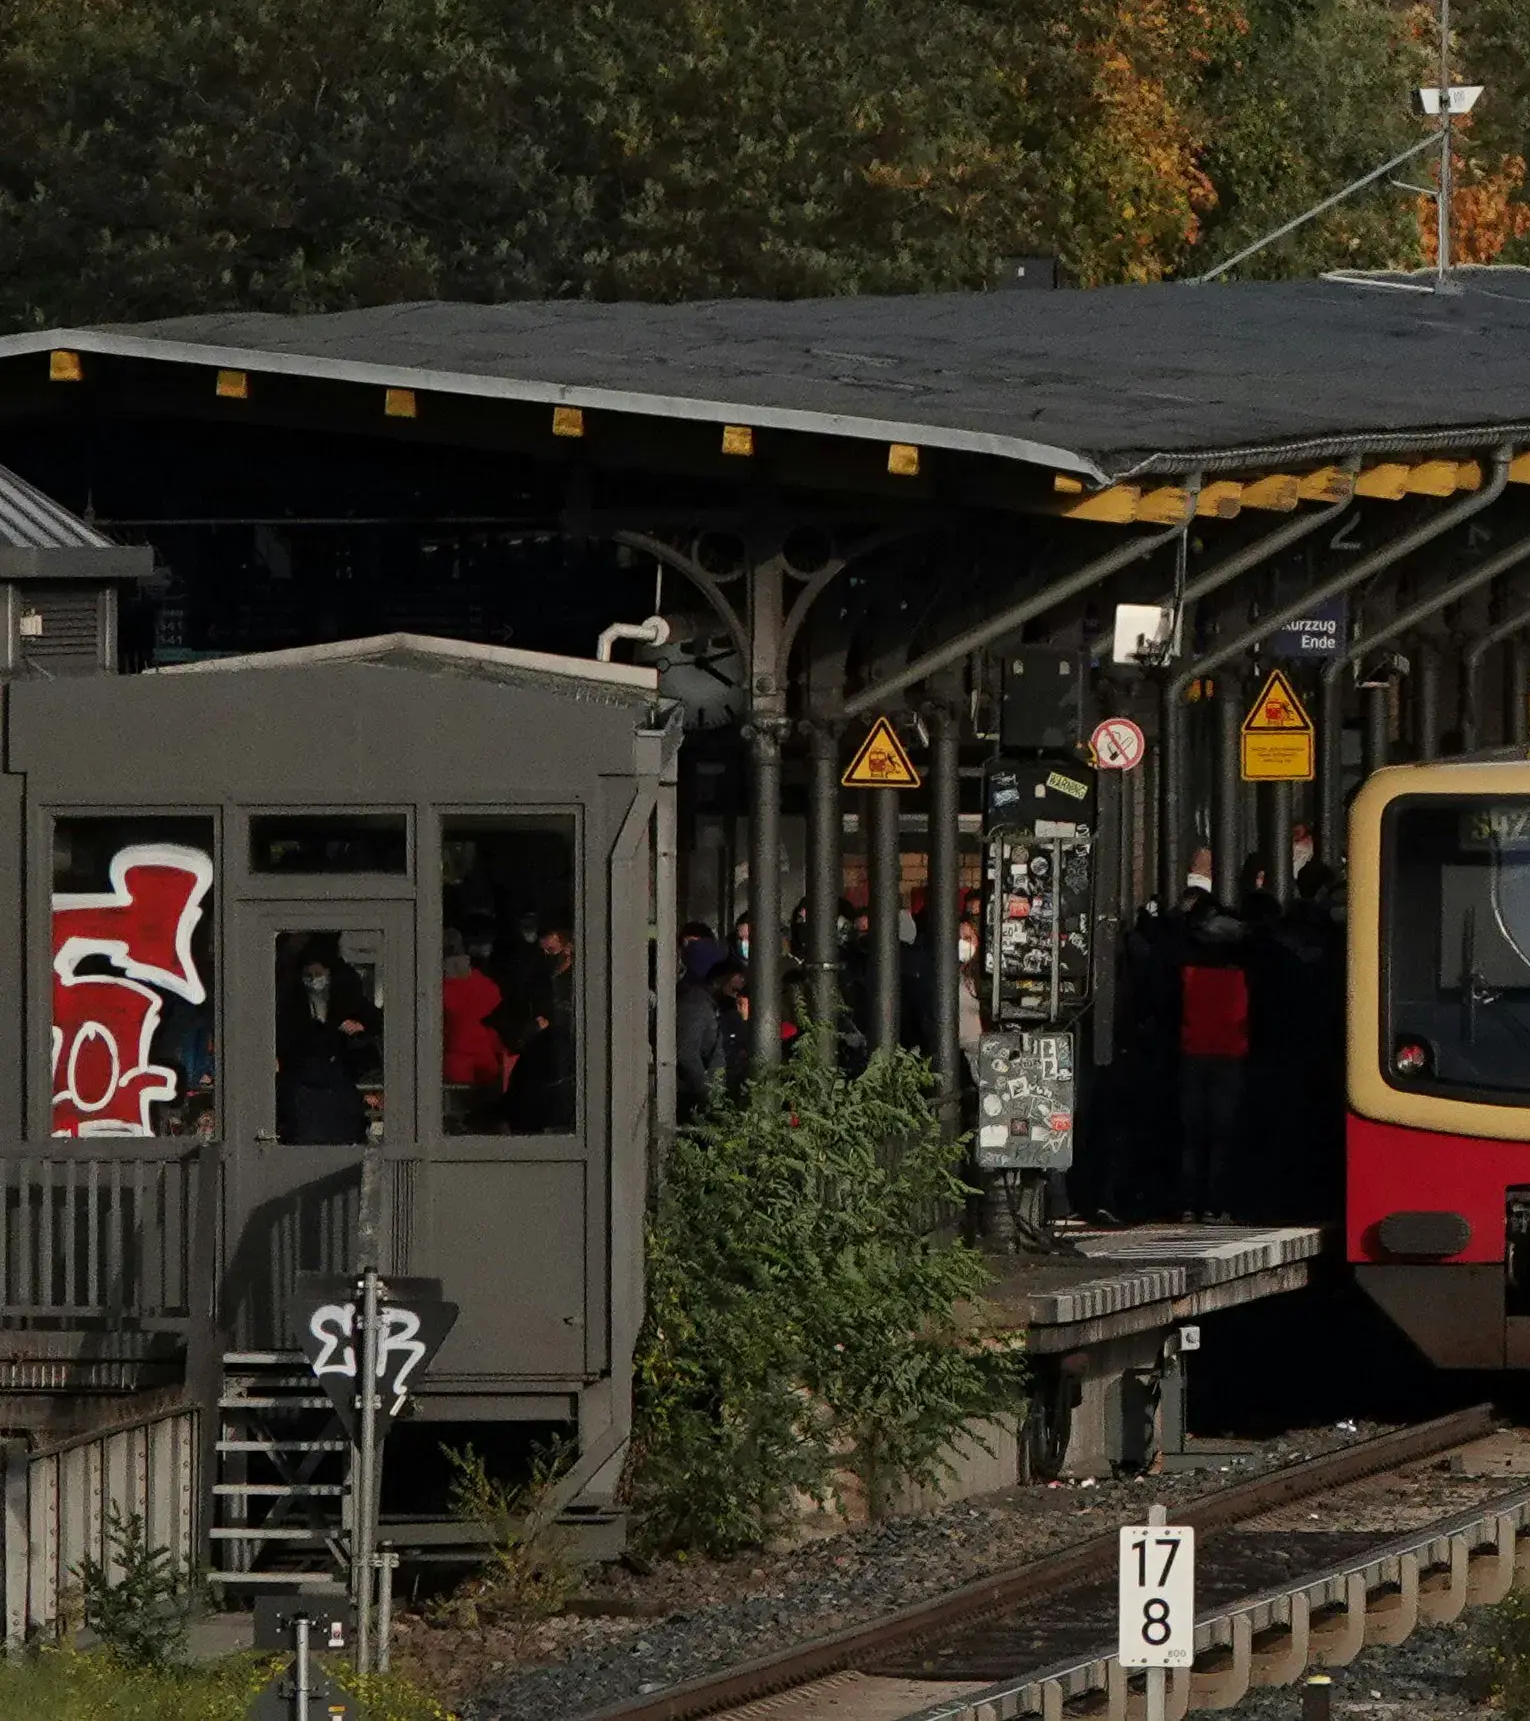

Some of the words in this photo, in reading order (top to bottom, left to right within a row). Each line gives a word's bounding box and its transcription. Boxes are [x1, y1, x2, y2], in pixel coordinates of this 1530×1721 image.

[1301, 635, 1336, 649] Ende
[1131, 1539, 1180, 1589] 17
[1141, 1598, 1171, 1646] 8
